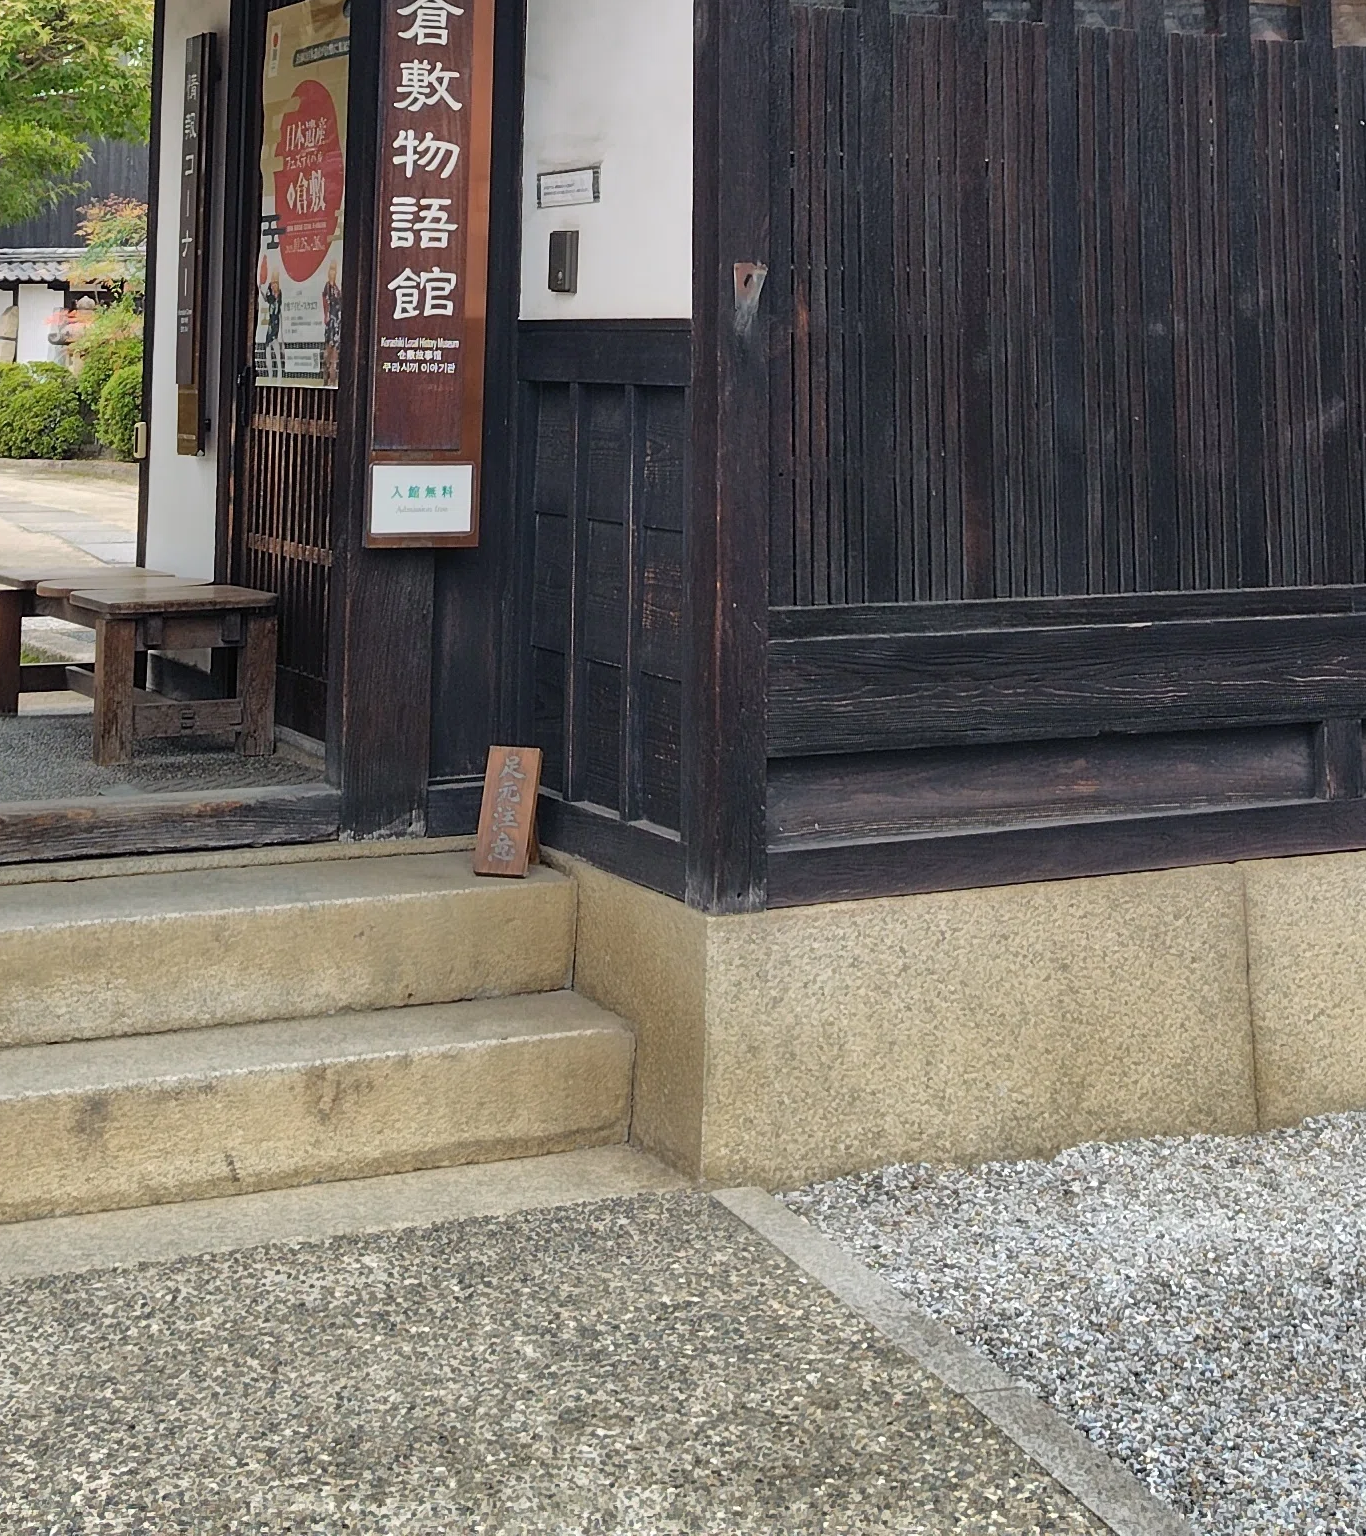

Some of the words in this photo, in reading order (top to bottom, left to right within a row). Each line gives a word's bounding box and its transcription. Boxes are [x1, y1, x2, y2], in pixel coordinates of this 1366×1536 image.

[391, 485, 452, 499] 入館無料
[487, 756, 526, 862] 足元注意
